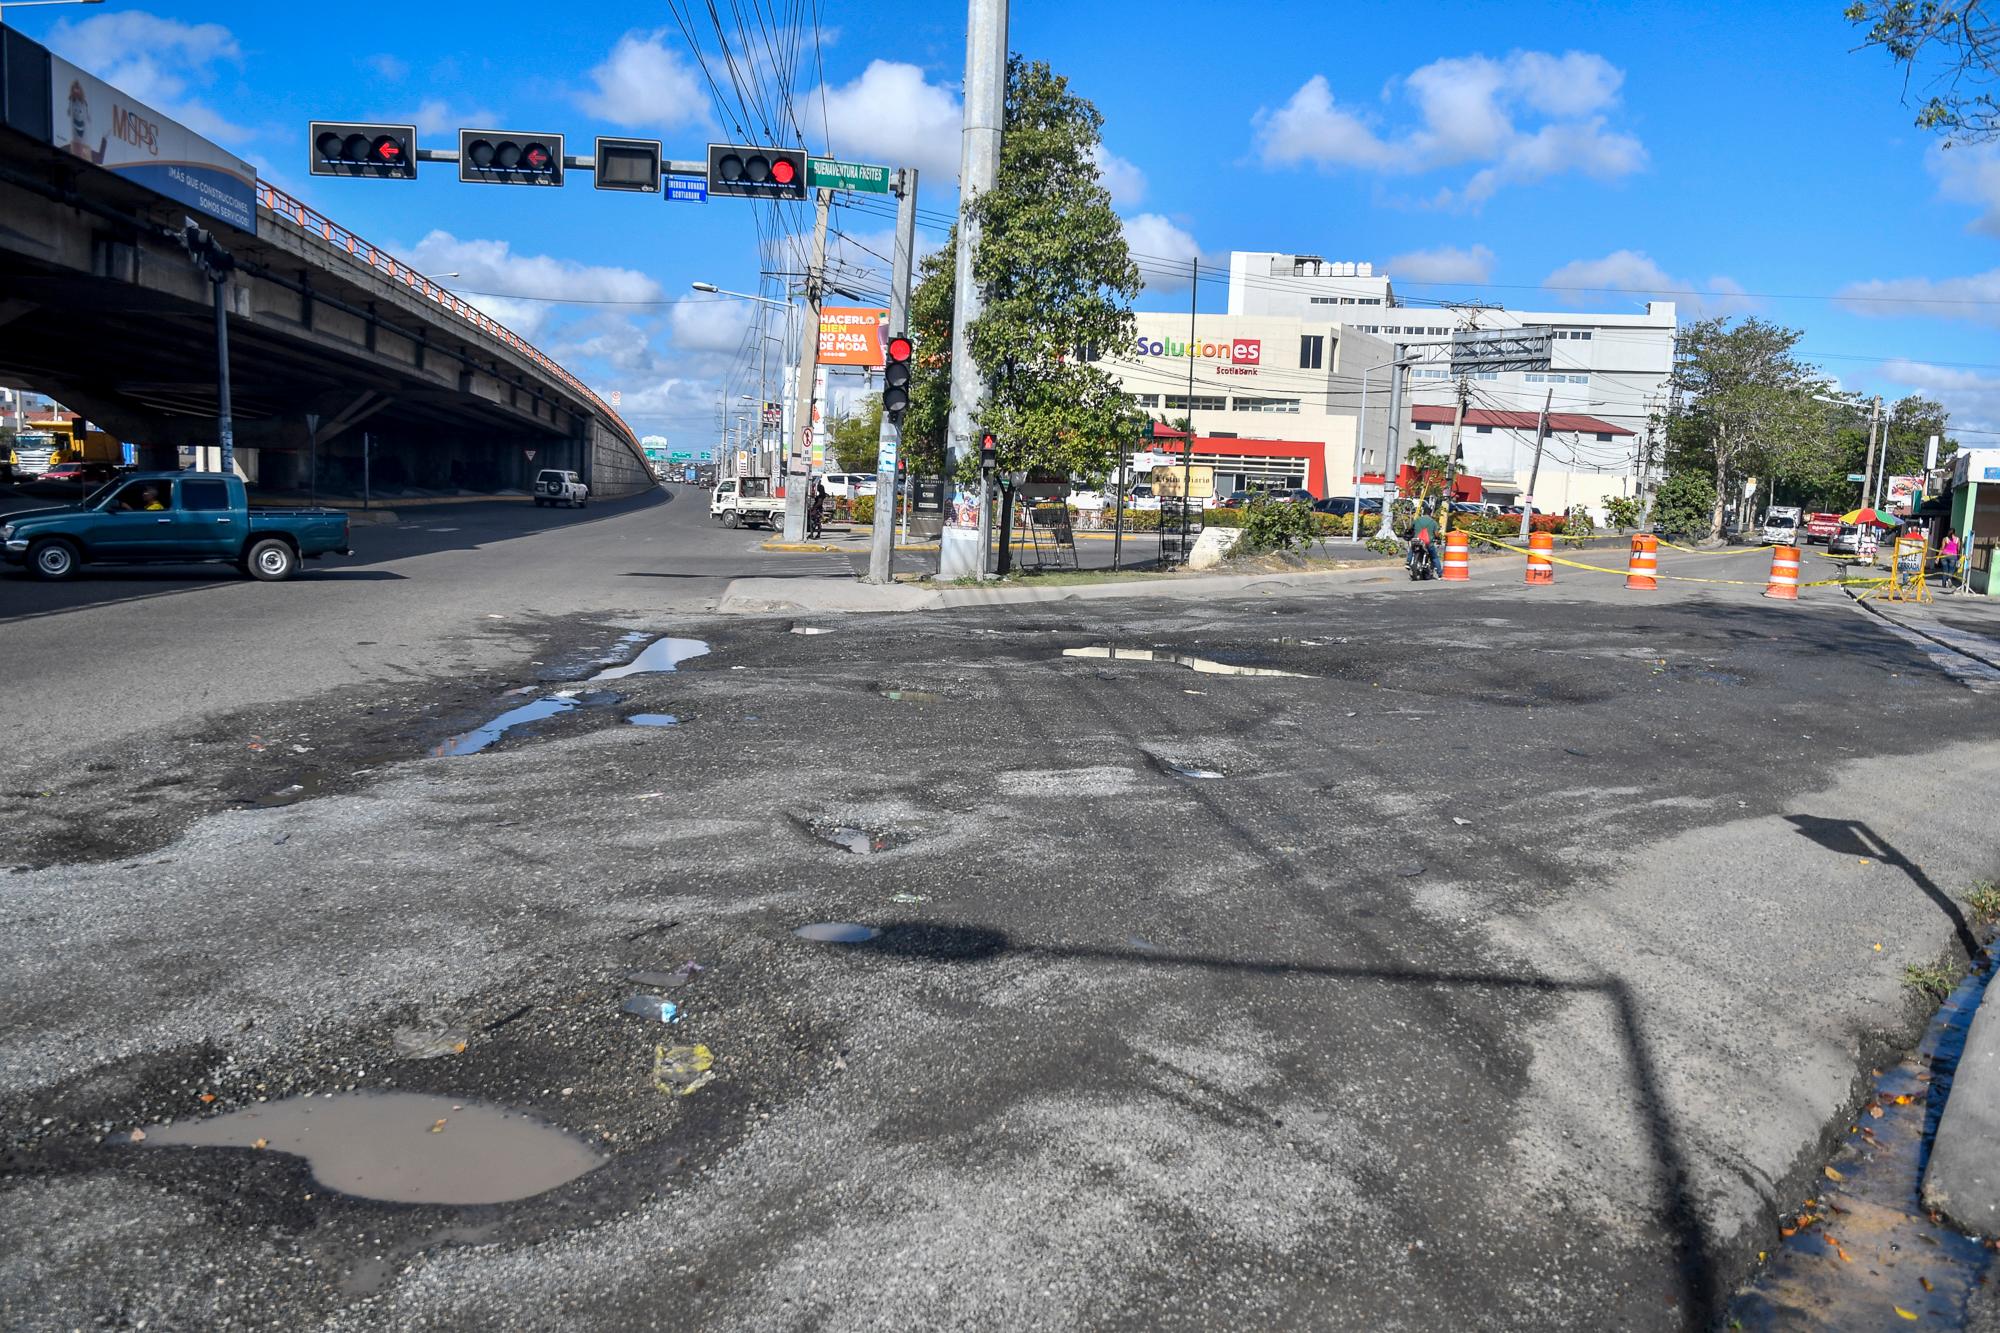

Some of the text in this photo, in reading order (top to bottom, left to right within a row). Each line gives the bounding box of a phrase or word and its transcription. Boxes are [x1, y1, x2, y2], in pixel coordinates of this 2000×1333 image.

[186, 175, 199, 190] QUE
[820, 315, 875, 325] HACERLO
[820, 324, 847, 333] BIEN
[820, 333, 867, 343] NO PASA
[820, 342, 868, 352] DE MODA
[1137, 336, 1259, 359] Soluciones
